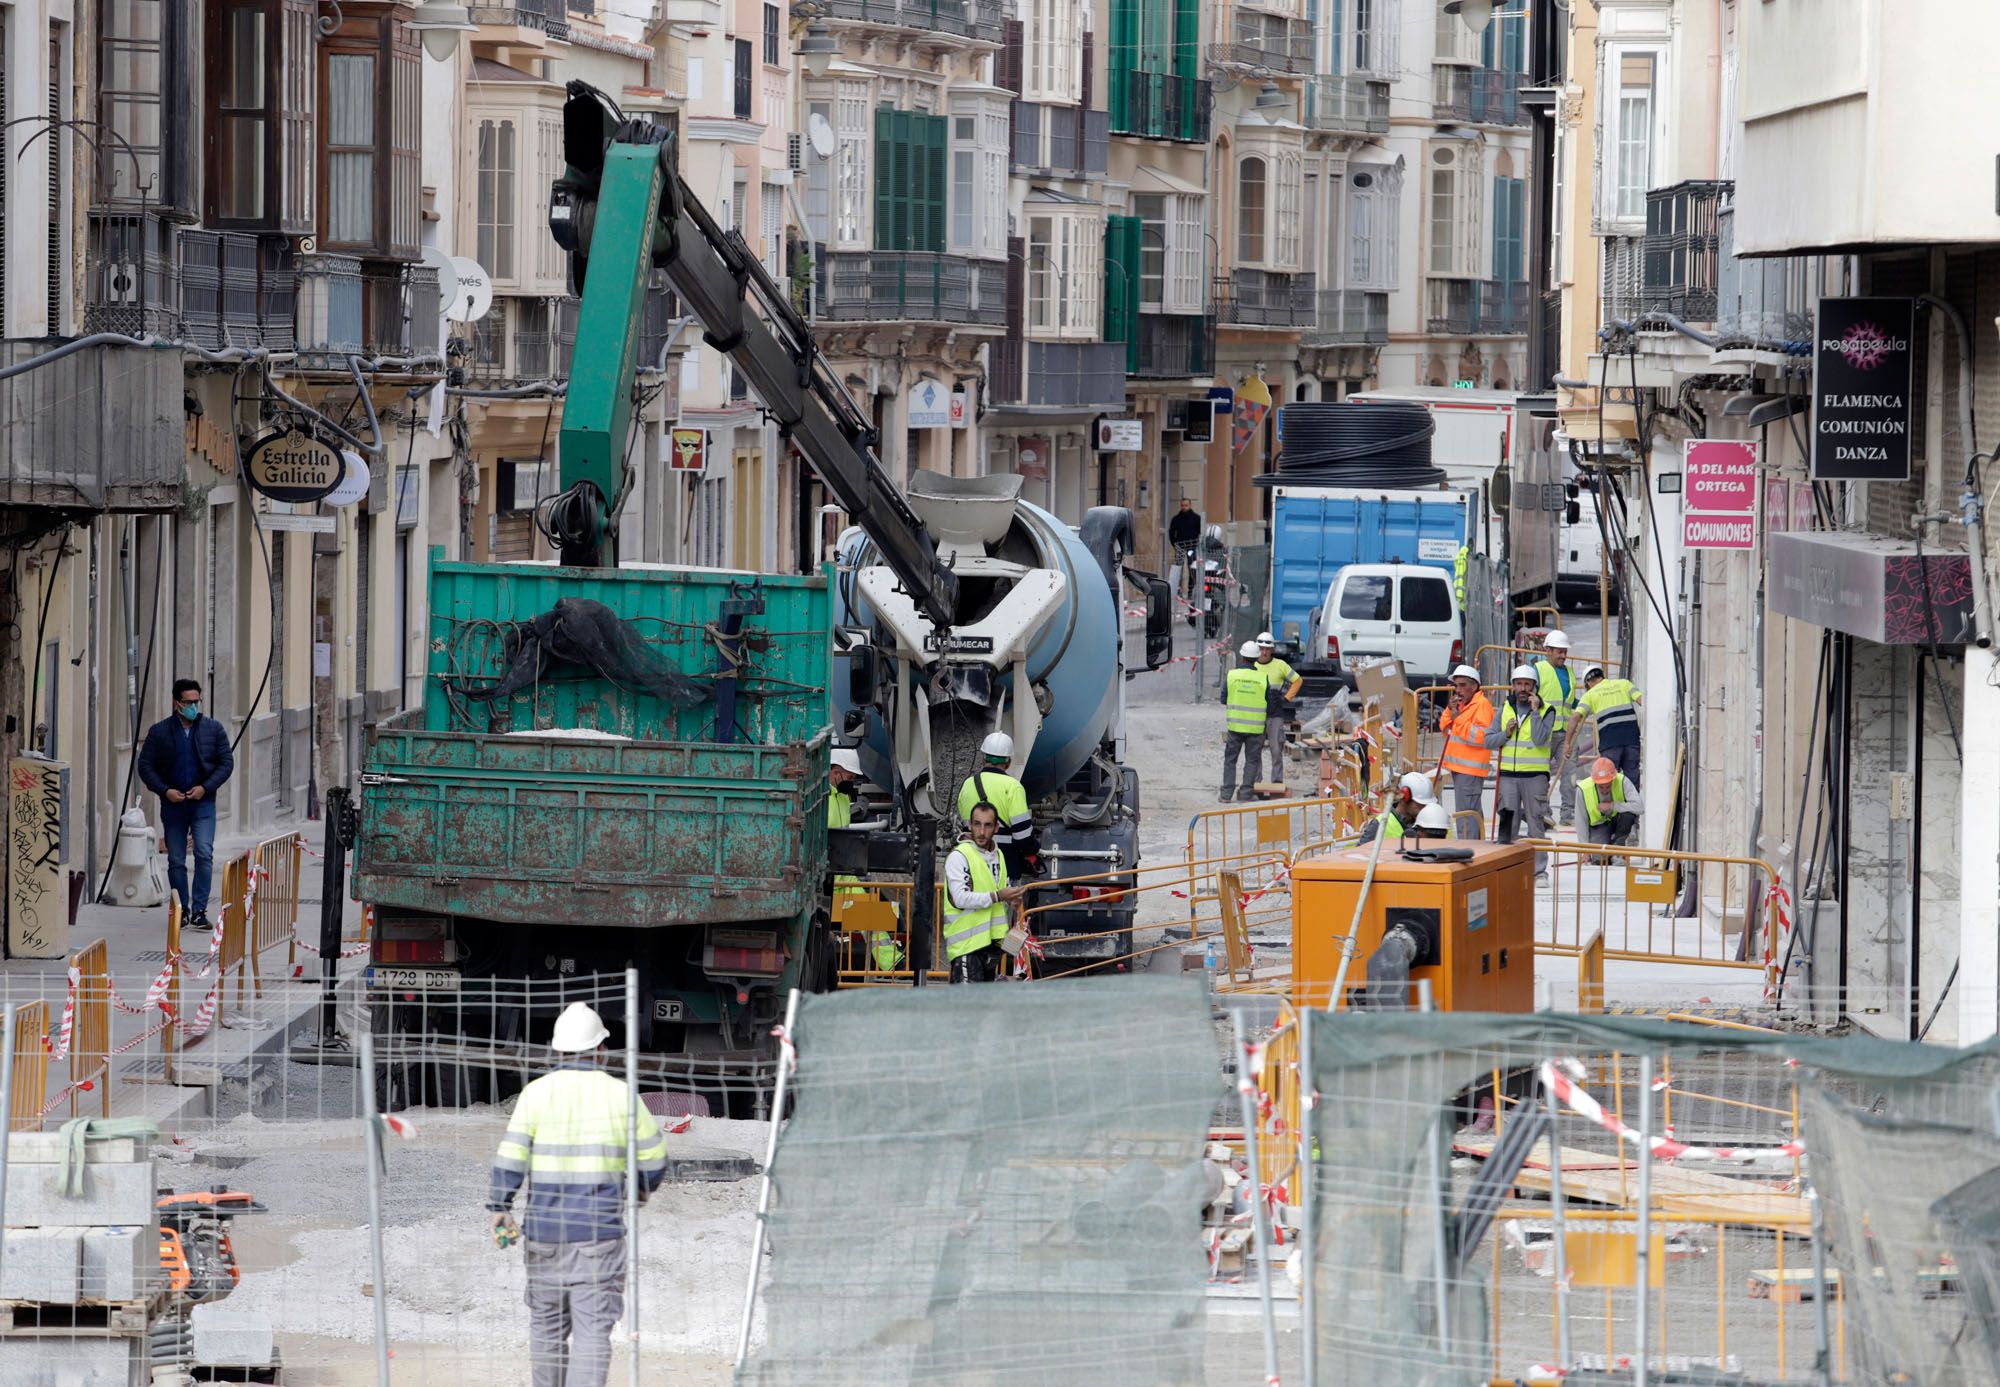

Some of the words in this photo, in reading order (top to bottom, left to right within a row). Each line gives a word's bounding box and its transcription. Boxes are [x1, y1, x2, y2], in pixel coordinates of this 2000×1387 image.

[1822, 335, 1907, 358] rosapeula
[1824, 394, 1902, 408] FLAMENCA
[1819, 417, 1905, 434] COMUNIÓN
[262, 448, 330, 466] Estrella
[1835, 447, 1888, 460] DANZA
[264, 465, 327, 484] Galicia
[1688, 463, 1699, 474] M
[1701, 463, 1724, 475] DEL
[1726, 464, 1754, 476] MAR
[1695, 480, 1746, 492] ORTEGA
[1687, 522, 1752, 542] COMUNIONES
[382, 970, 417, 986] 1728
[658, 1004, 680, 1017] SP
